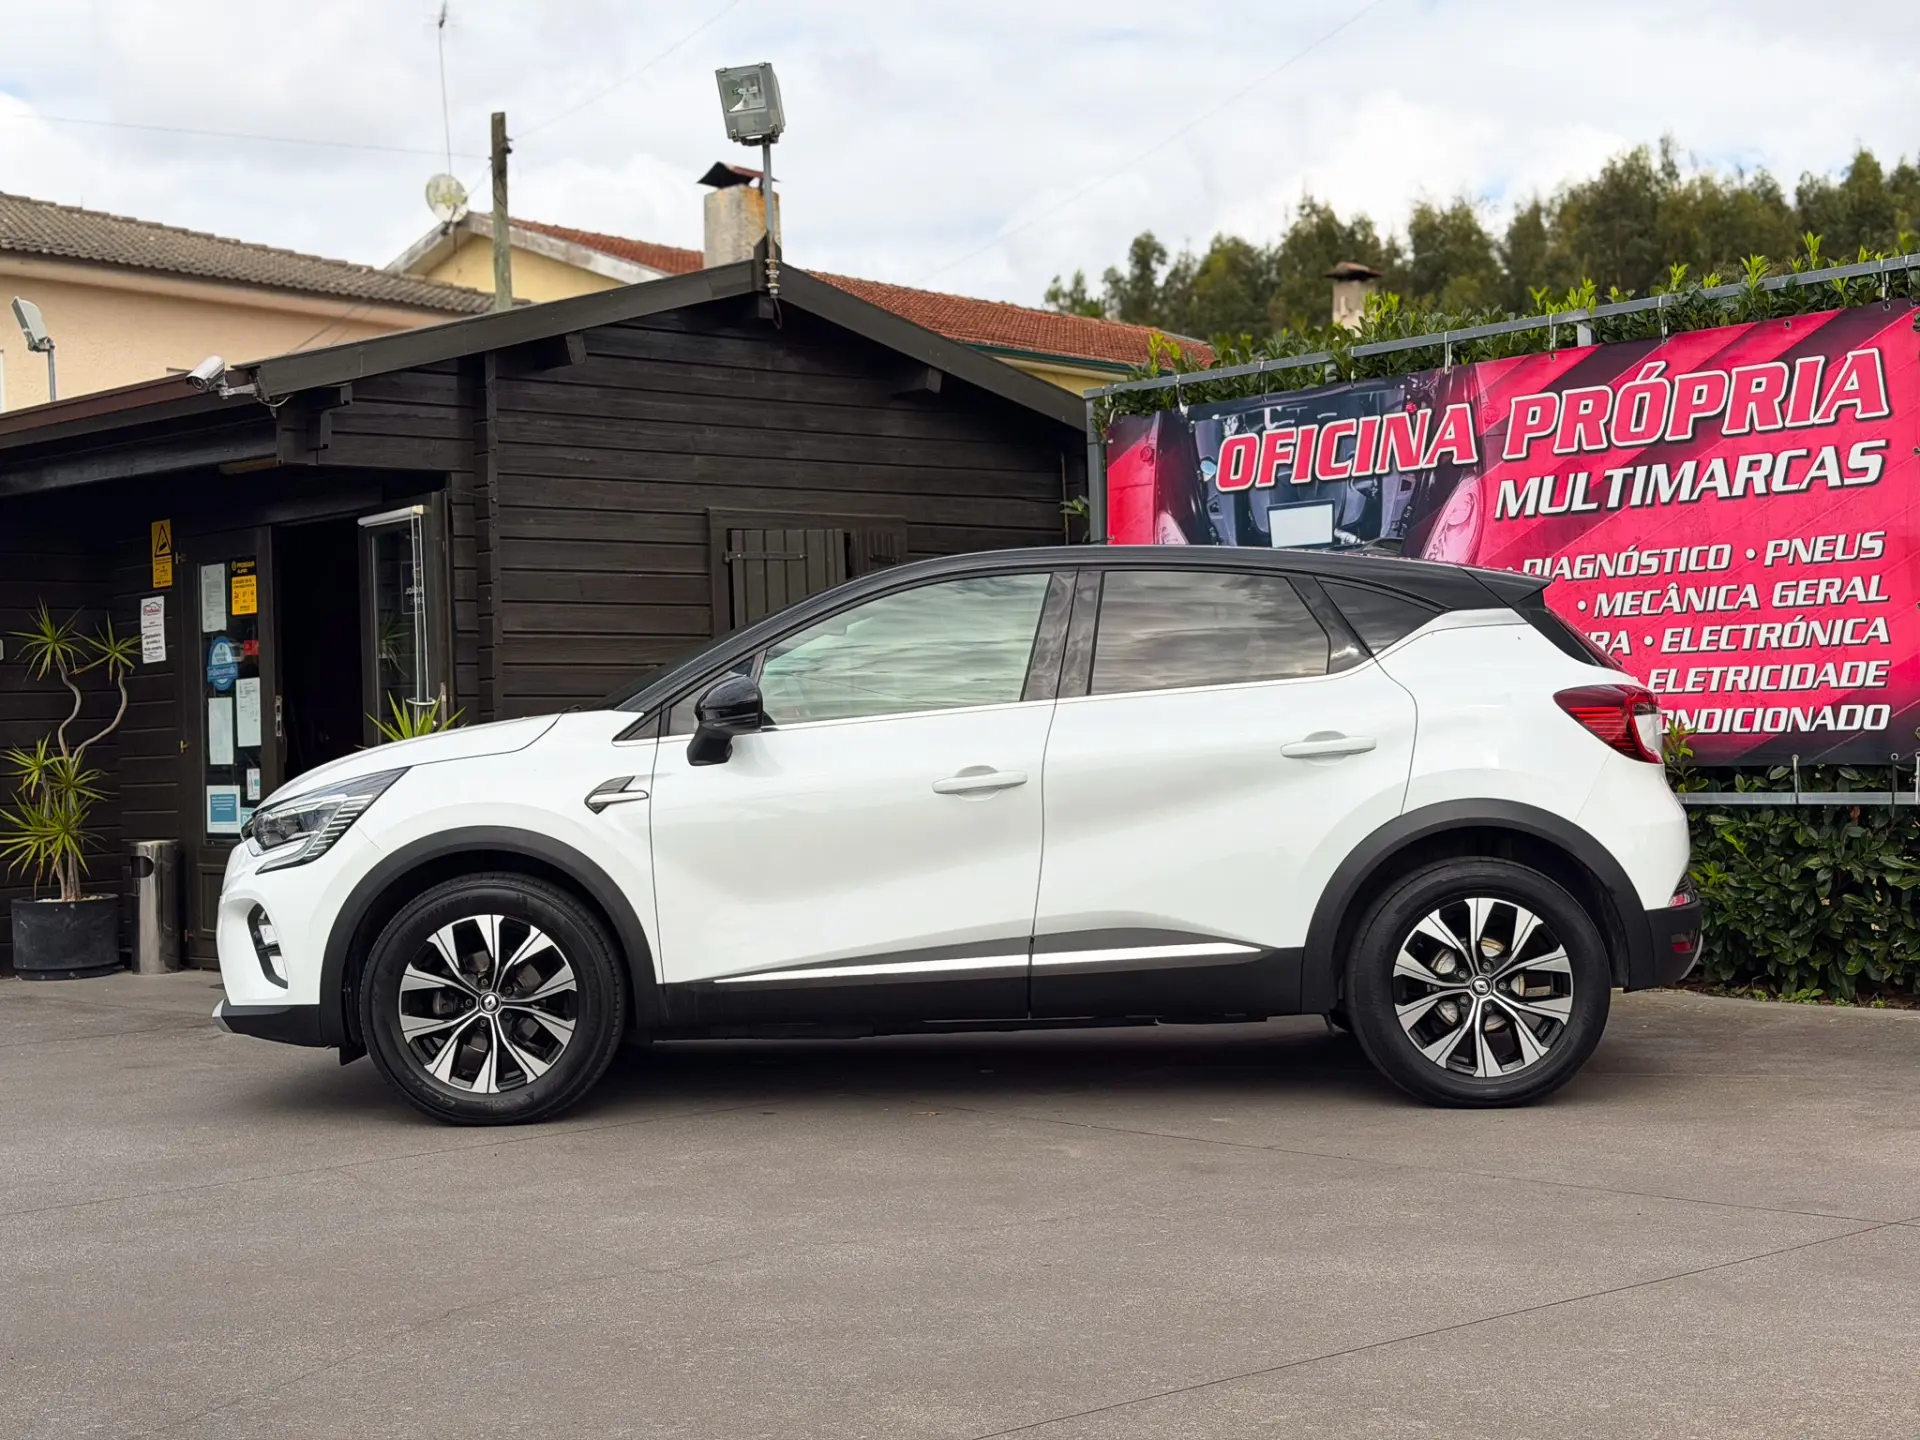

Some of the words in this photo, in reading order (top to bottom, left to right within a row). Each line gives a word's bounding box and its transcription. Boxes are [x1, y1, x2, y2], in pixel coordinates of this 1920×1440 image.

[1215, 403, 1479, 492] OFICINA
[1501, 347, 1890, 460] PRÓPRIA
[1494, 440, 1888, 519] MULTIMARCAS
[1523, 544, 1732, 581] DIAGNÓSTICO
[1763, 531, 1887, 567] PNEUS
[1593, 582, 1760, 618] MECÂNICA
[1771, 575, 1890, 608] GERAL
[1660, 614, 1890, 654] ELECTRÓNICA
[1647, 660, 1890, 694] ELETRICIDADE
